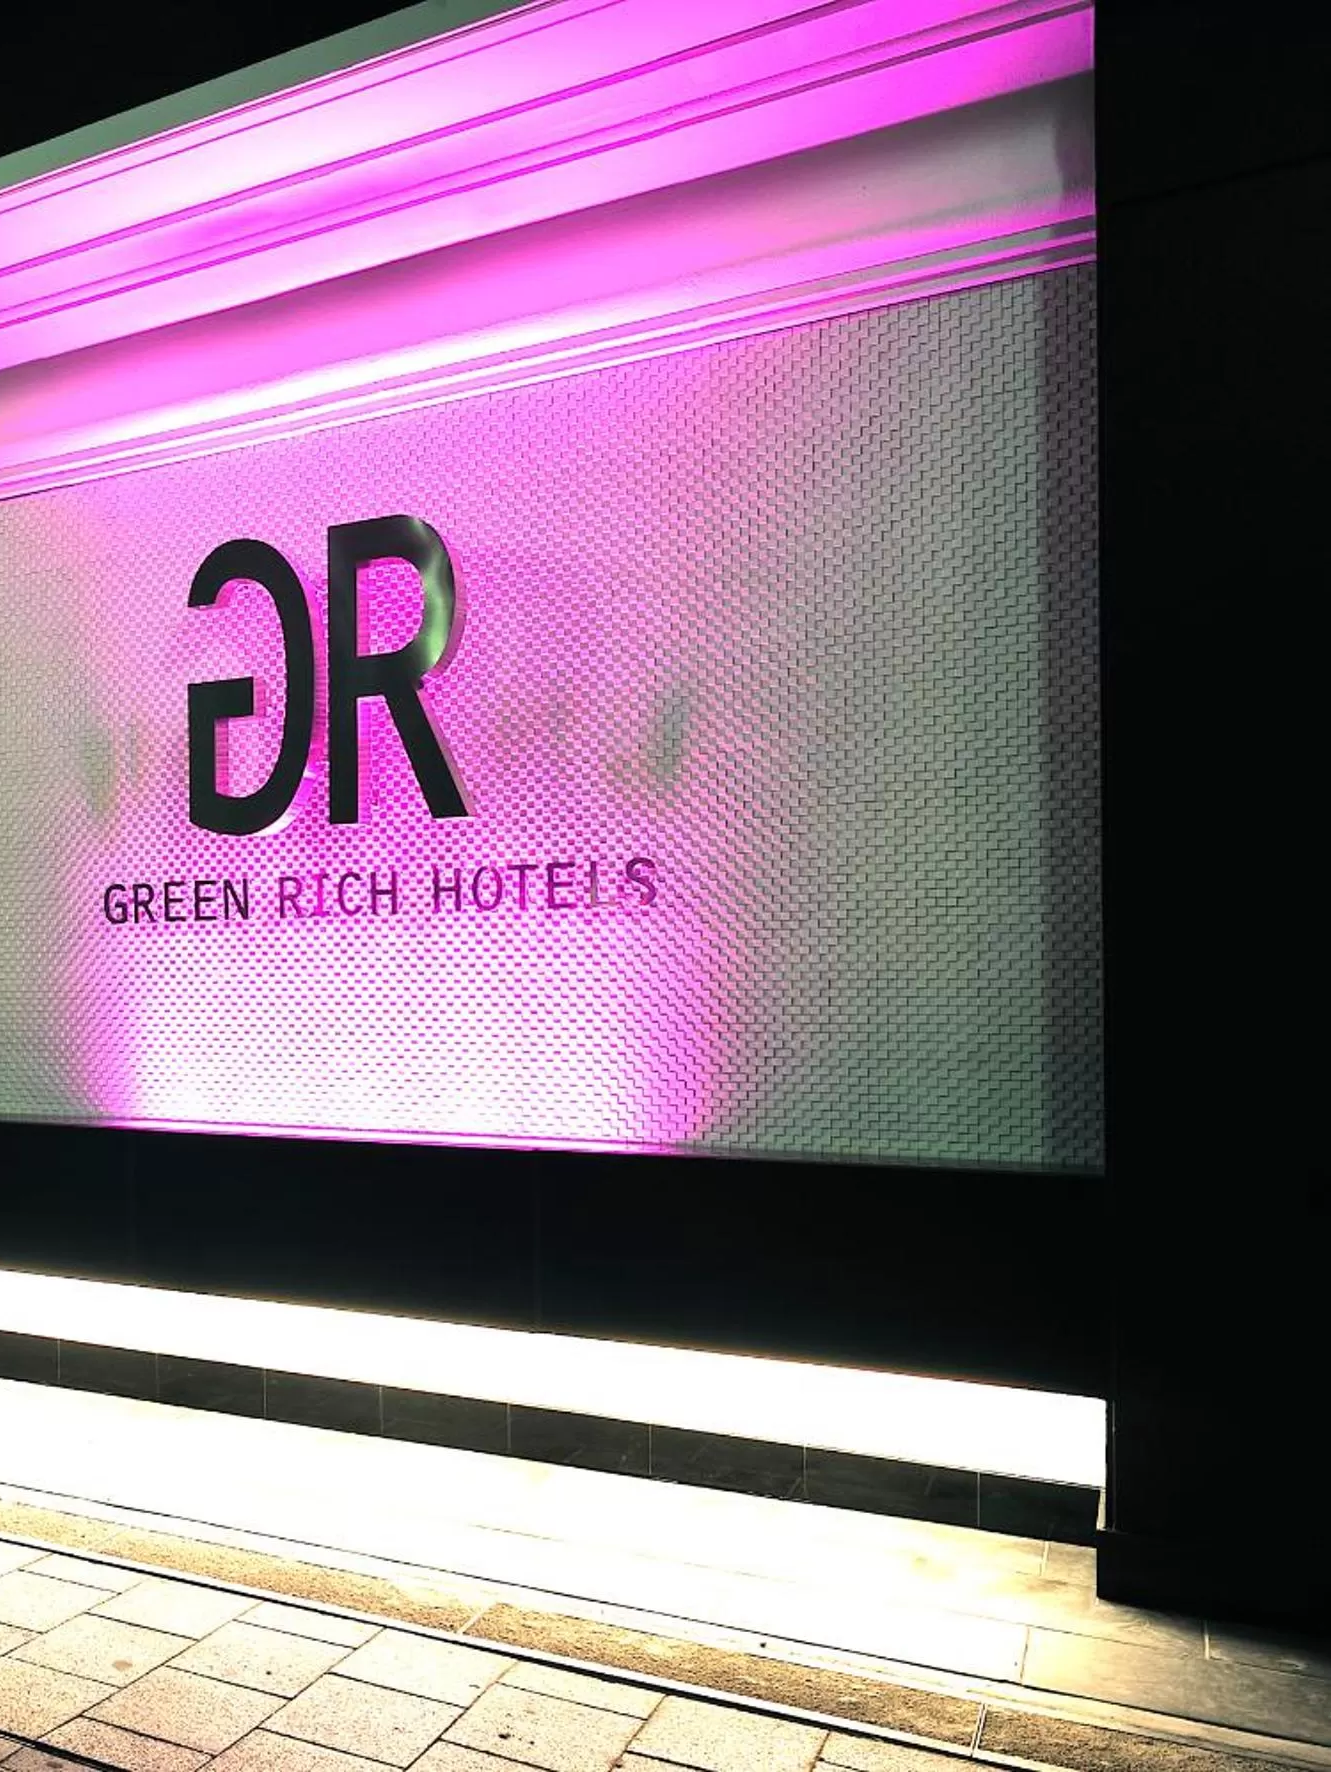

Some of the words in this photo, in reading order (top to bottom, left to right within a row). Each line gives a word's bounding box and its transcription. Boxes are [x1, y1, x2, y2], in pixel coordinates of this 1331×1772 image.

[103, 878, 249, 924] GREEN
[279, 871, 400, 918] RICH
[431, 857, 658, 913] HOTELS
